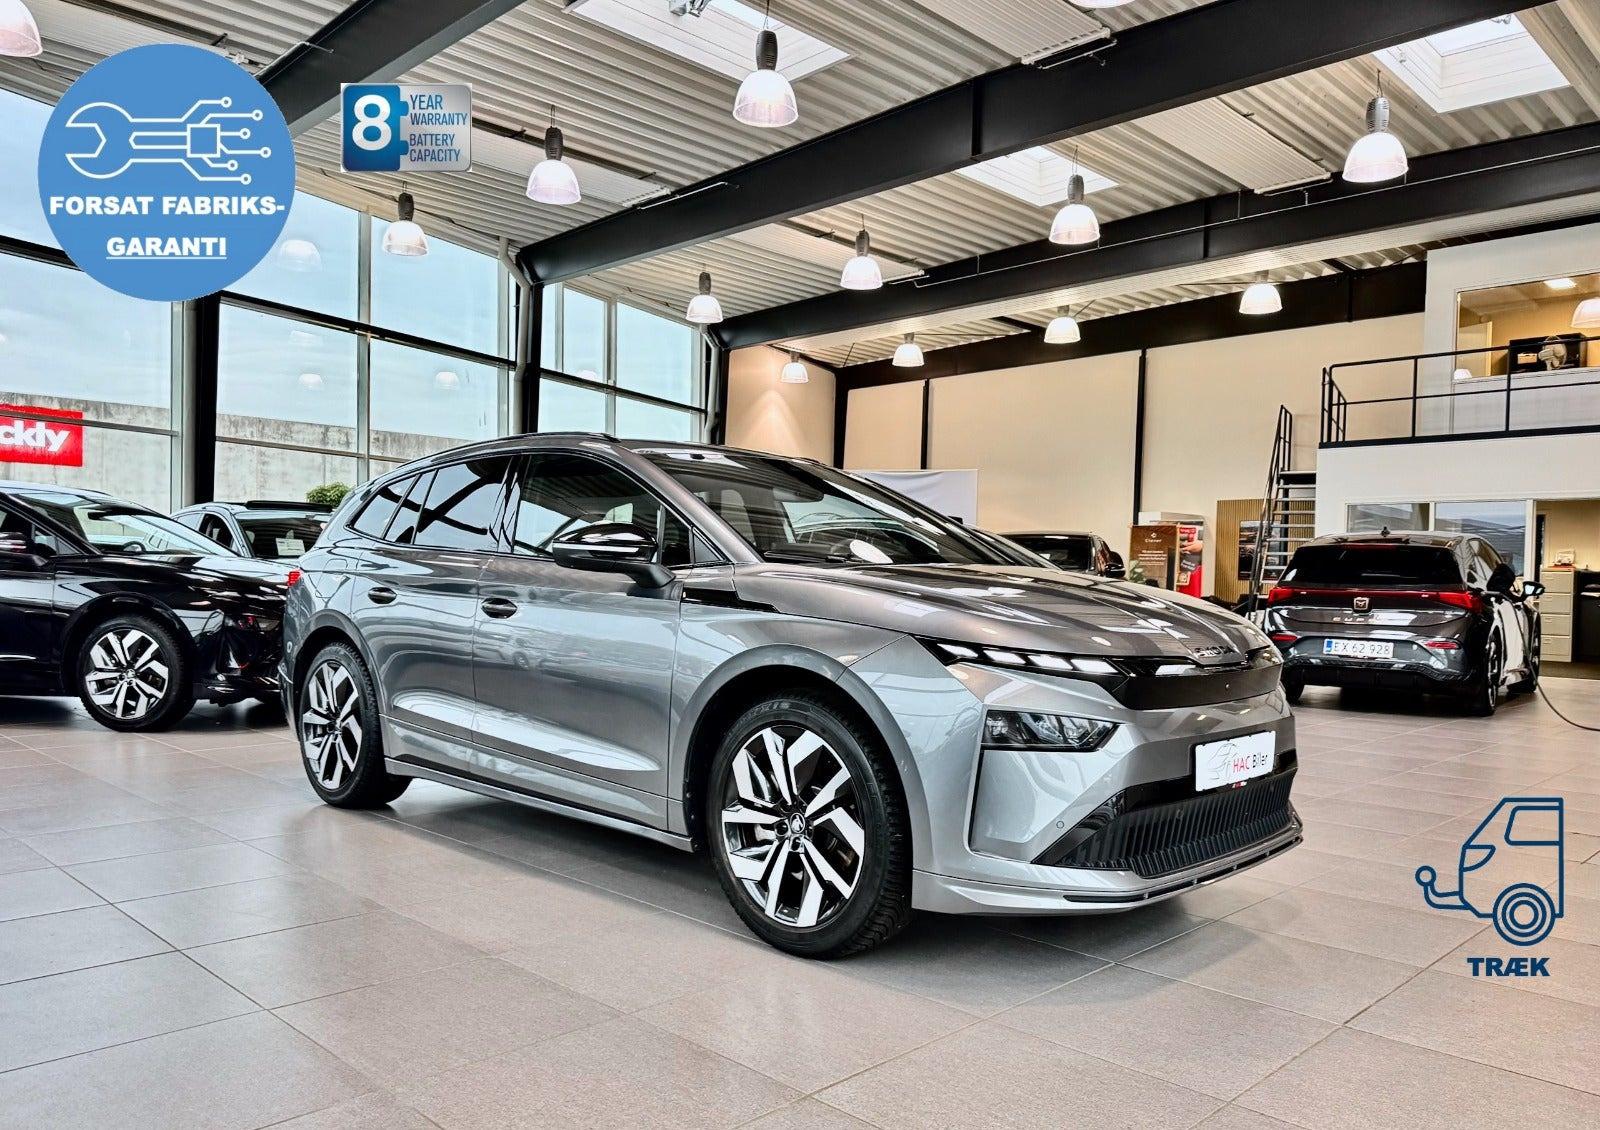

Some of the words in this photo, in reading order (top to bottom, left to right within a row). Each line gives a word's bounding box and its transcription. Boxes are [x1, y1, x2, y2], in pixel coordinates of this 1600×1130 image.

[1334, 642, 1349, 652] EX
[1352, 643, 1366, 654] 62
[1370, 644, 1390, 655] 928
[1233, 756, 1251, 773] HAC
[1252, 752, 1269, 769] Biler
